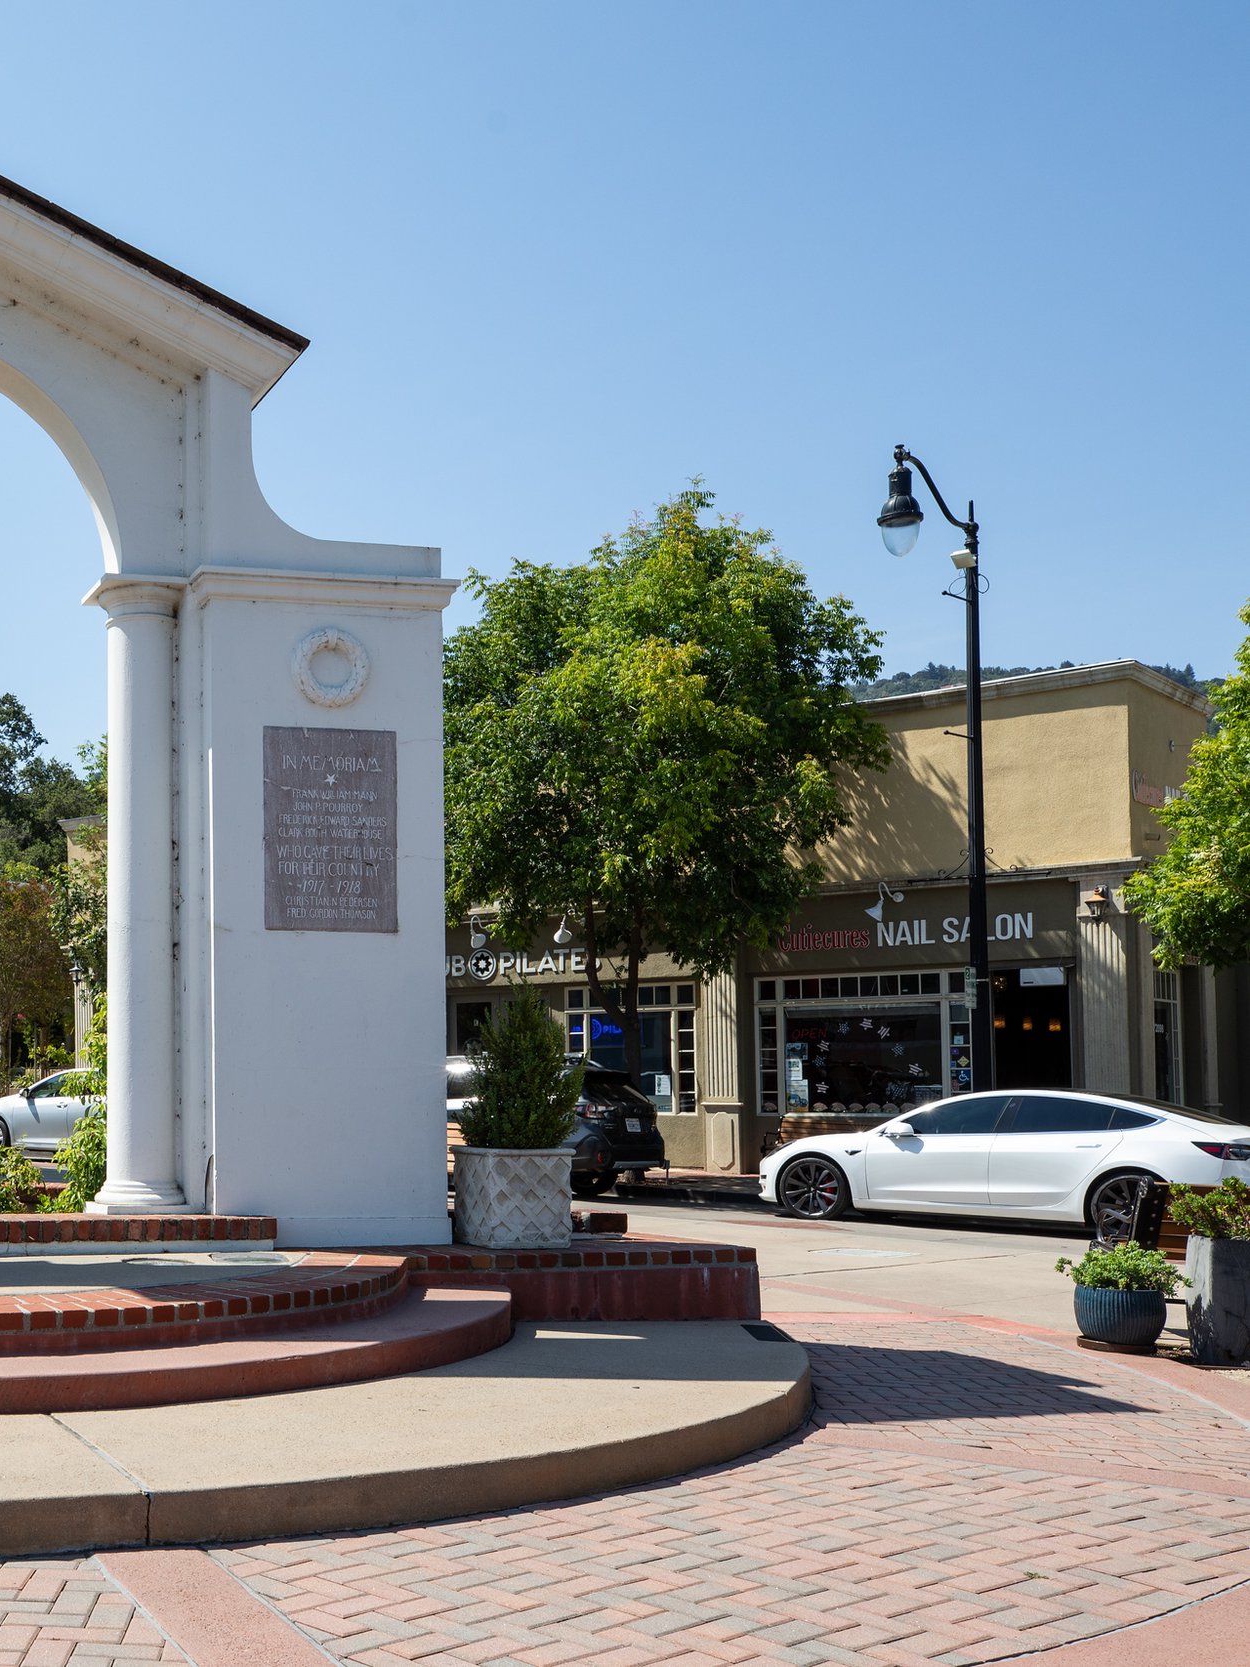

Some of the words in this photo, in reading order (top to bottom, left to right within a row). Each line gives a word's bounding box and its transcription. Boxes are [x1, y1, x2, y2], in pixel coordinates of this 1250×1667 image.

[282, 754, 297, 770] IN
[299, 755, 382, 772] MEMORIAM
[292, 788, 319, 799] FRANK
[321, 789, 352, 800] WILLIAM
[353, 791, 379, 801] MANN
[293, 801, 313, 812] JOHN
[323, 803, 363, 814] POURROY
[352, 816, 387, 827] SANDERS
[276, 845, 301, 859] WHO
[334, 846, 361, 860] THEIR
[363, 847, 393, 861] LIVES
[278, 861, 300, 875] FOR
[339, 897, 378, 908] PEDERSEN
[287, 908, 306, 918] FRED
[309, 908, 338, 919] GORDON
[877, 919, 936, 947] NAIL
[792, 1026, 827, 1040] OPEN
